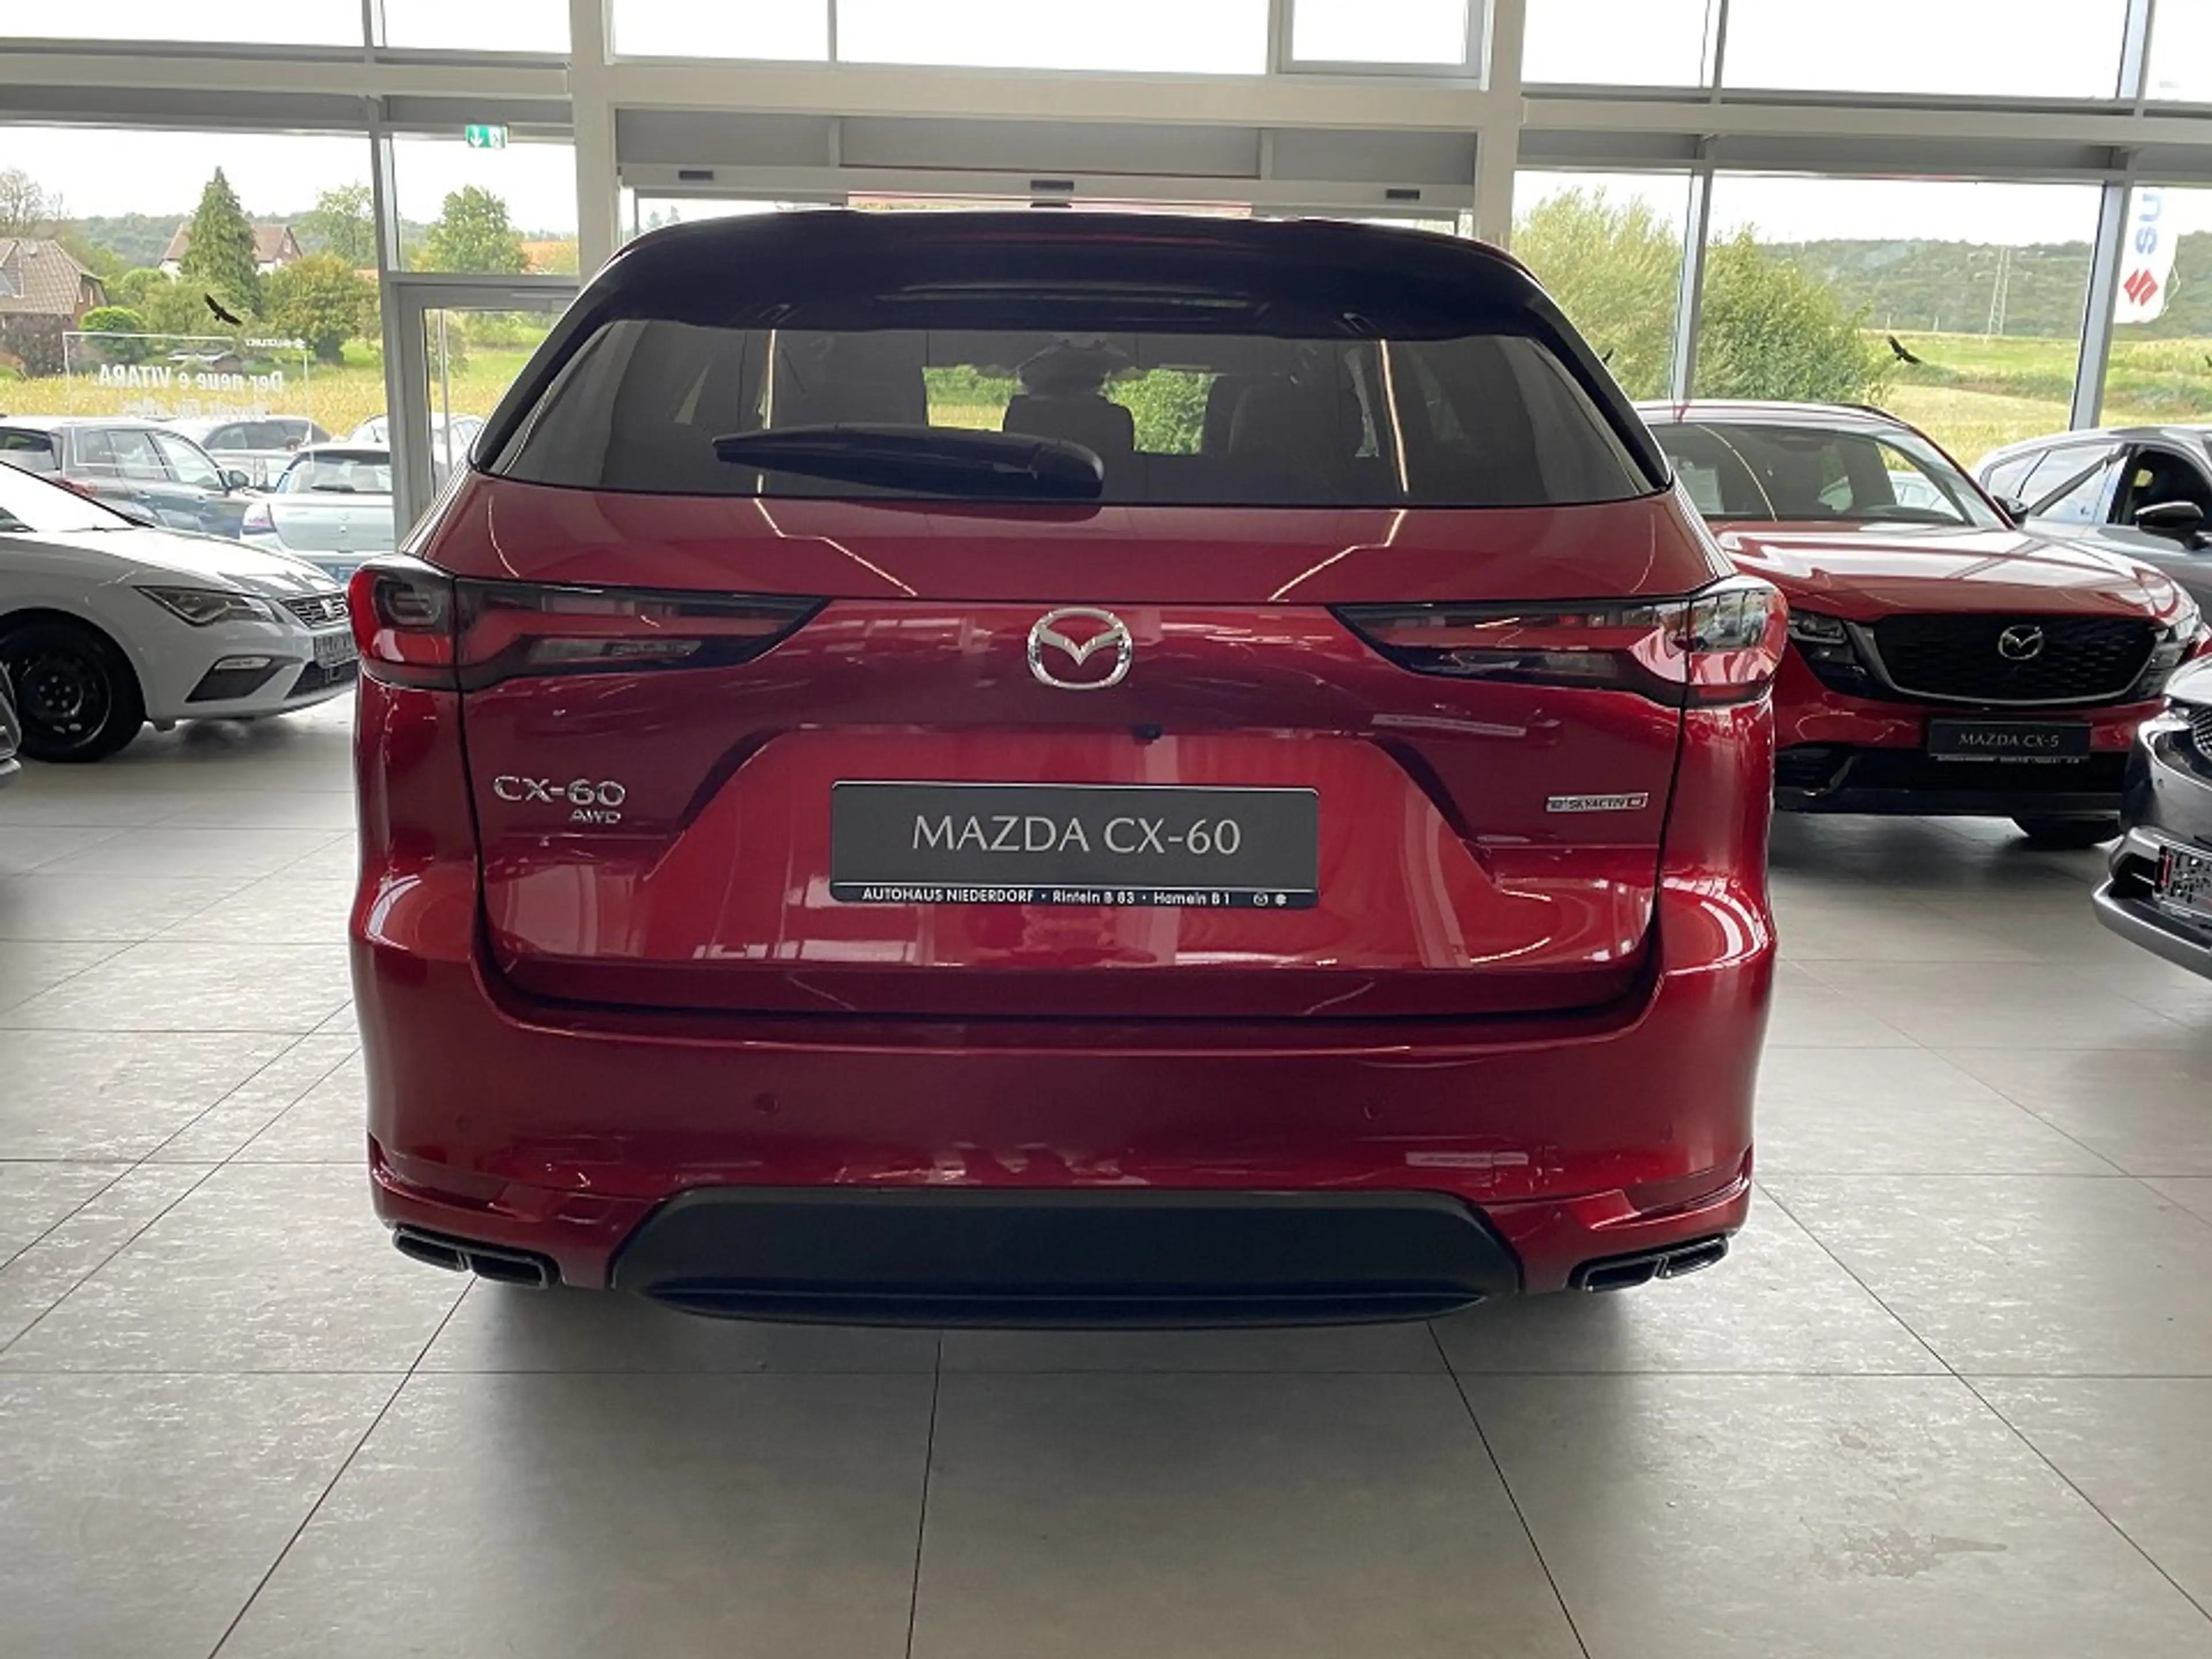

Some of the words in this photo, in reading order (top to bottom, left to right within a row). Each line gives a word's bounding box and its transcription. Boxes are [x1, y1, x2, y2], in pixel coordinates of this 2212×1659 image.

[1958, 733, 2018, 747] MAZDA
[2022, 734, 2060, 748] CX-5
[493, 774, 626, 806] CX-60
[570, 808, 622, 824] AWD
[912, 815, 1090, 853] MAZDA
[1103, 817, 1242, 856] CX-60
[862, 887, 943, 902] AUTOHAUS
[946, 889, 1035, 903] NIEDERDORF
[1052, 889, 1100, 904] Rinteln
